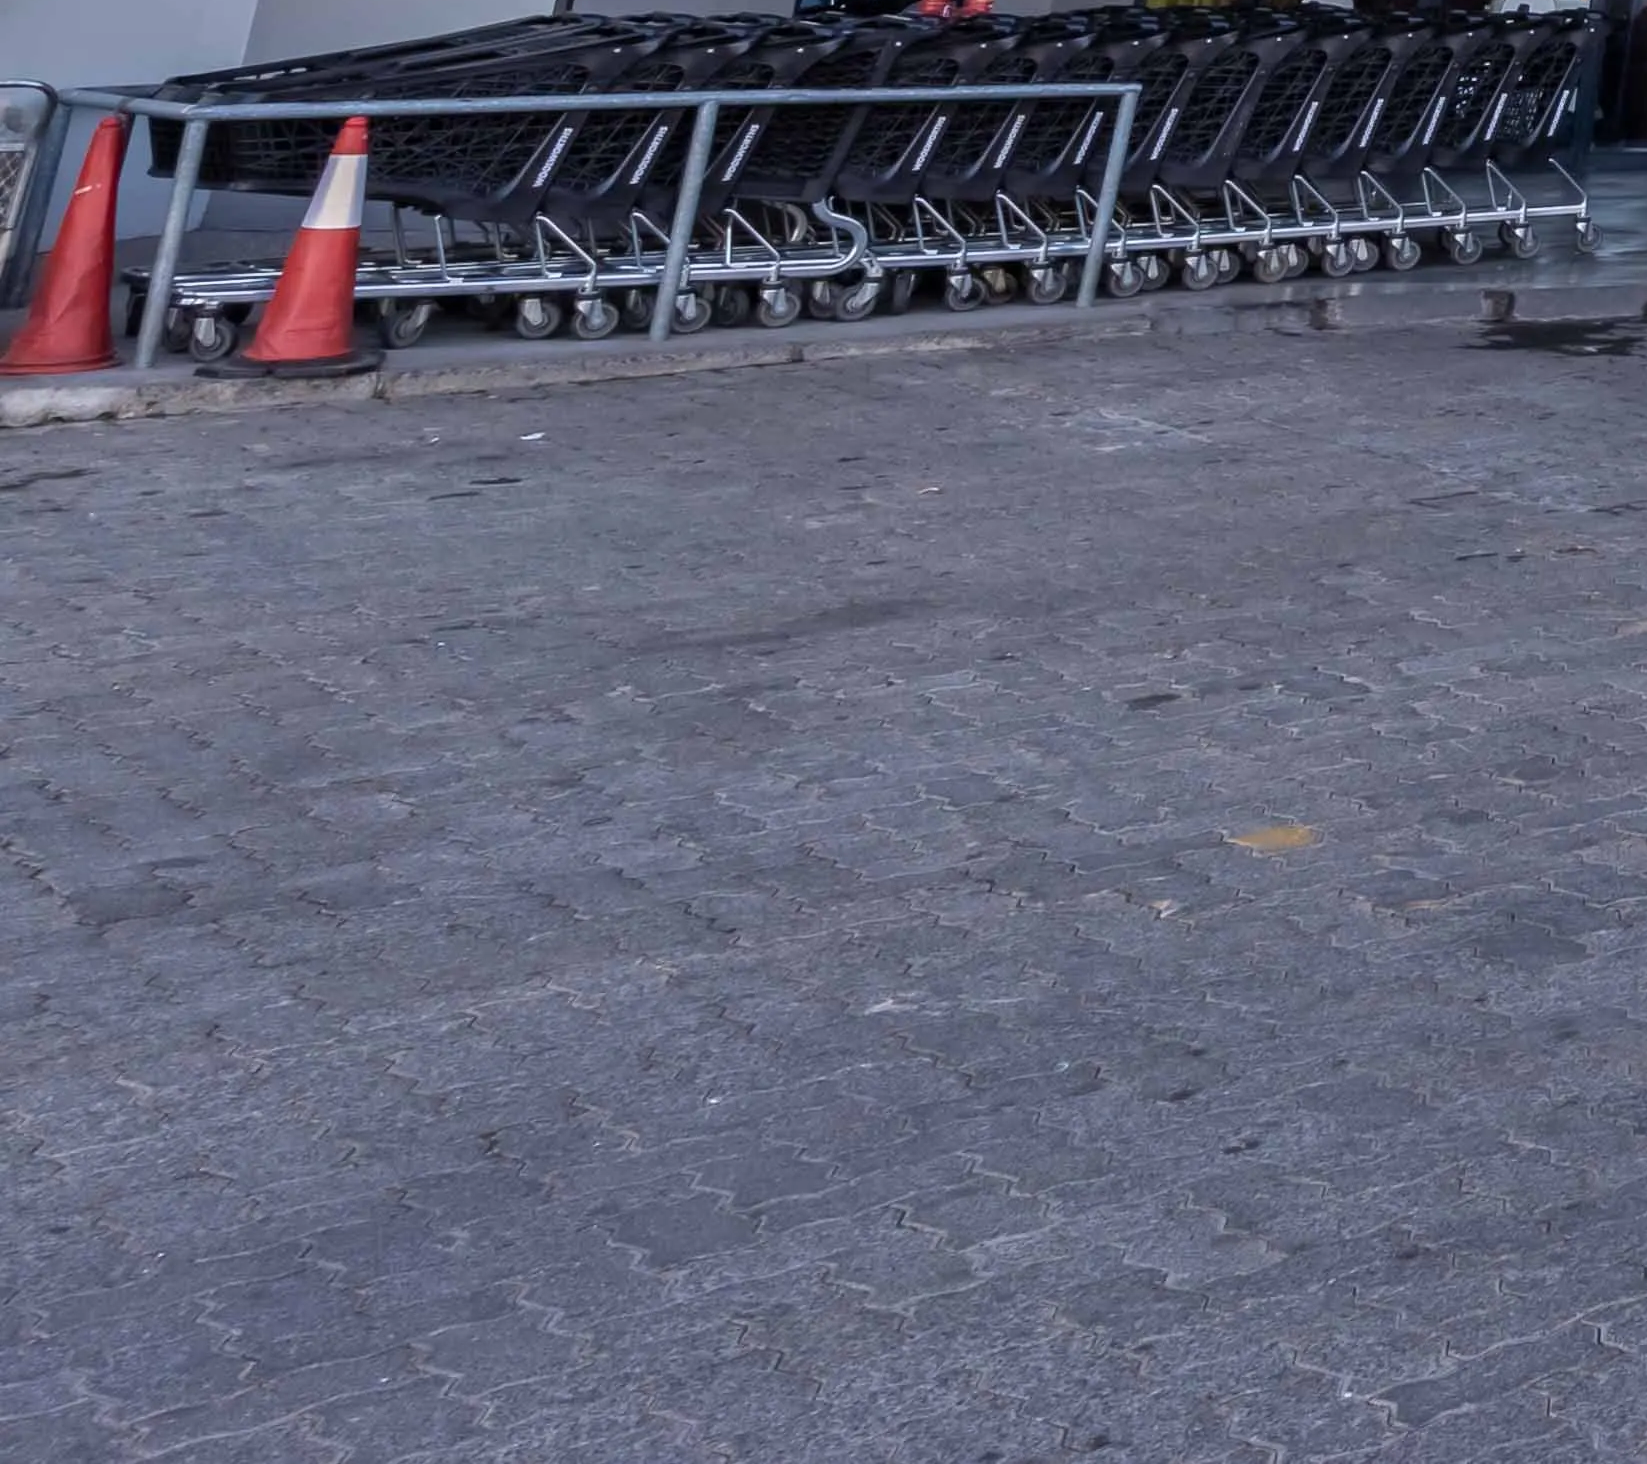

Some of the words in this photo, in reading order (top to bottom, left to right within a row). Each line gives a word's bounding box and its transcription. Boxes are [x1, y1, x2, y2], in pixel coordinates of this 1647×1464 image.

[533, 127, 574, 188] WOOLWORTHS
[629, 126, 669, 185] WOOLWORTHS
[721, 124, 760, 183] WOOLWORTHS
